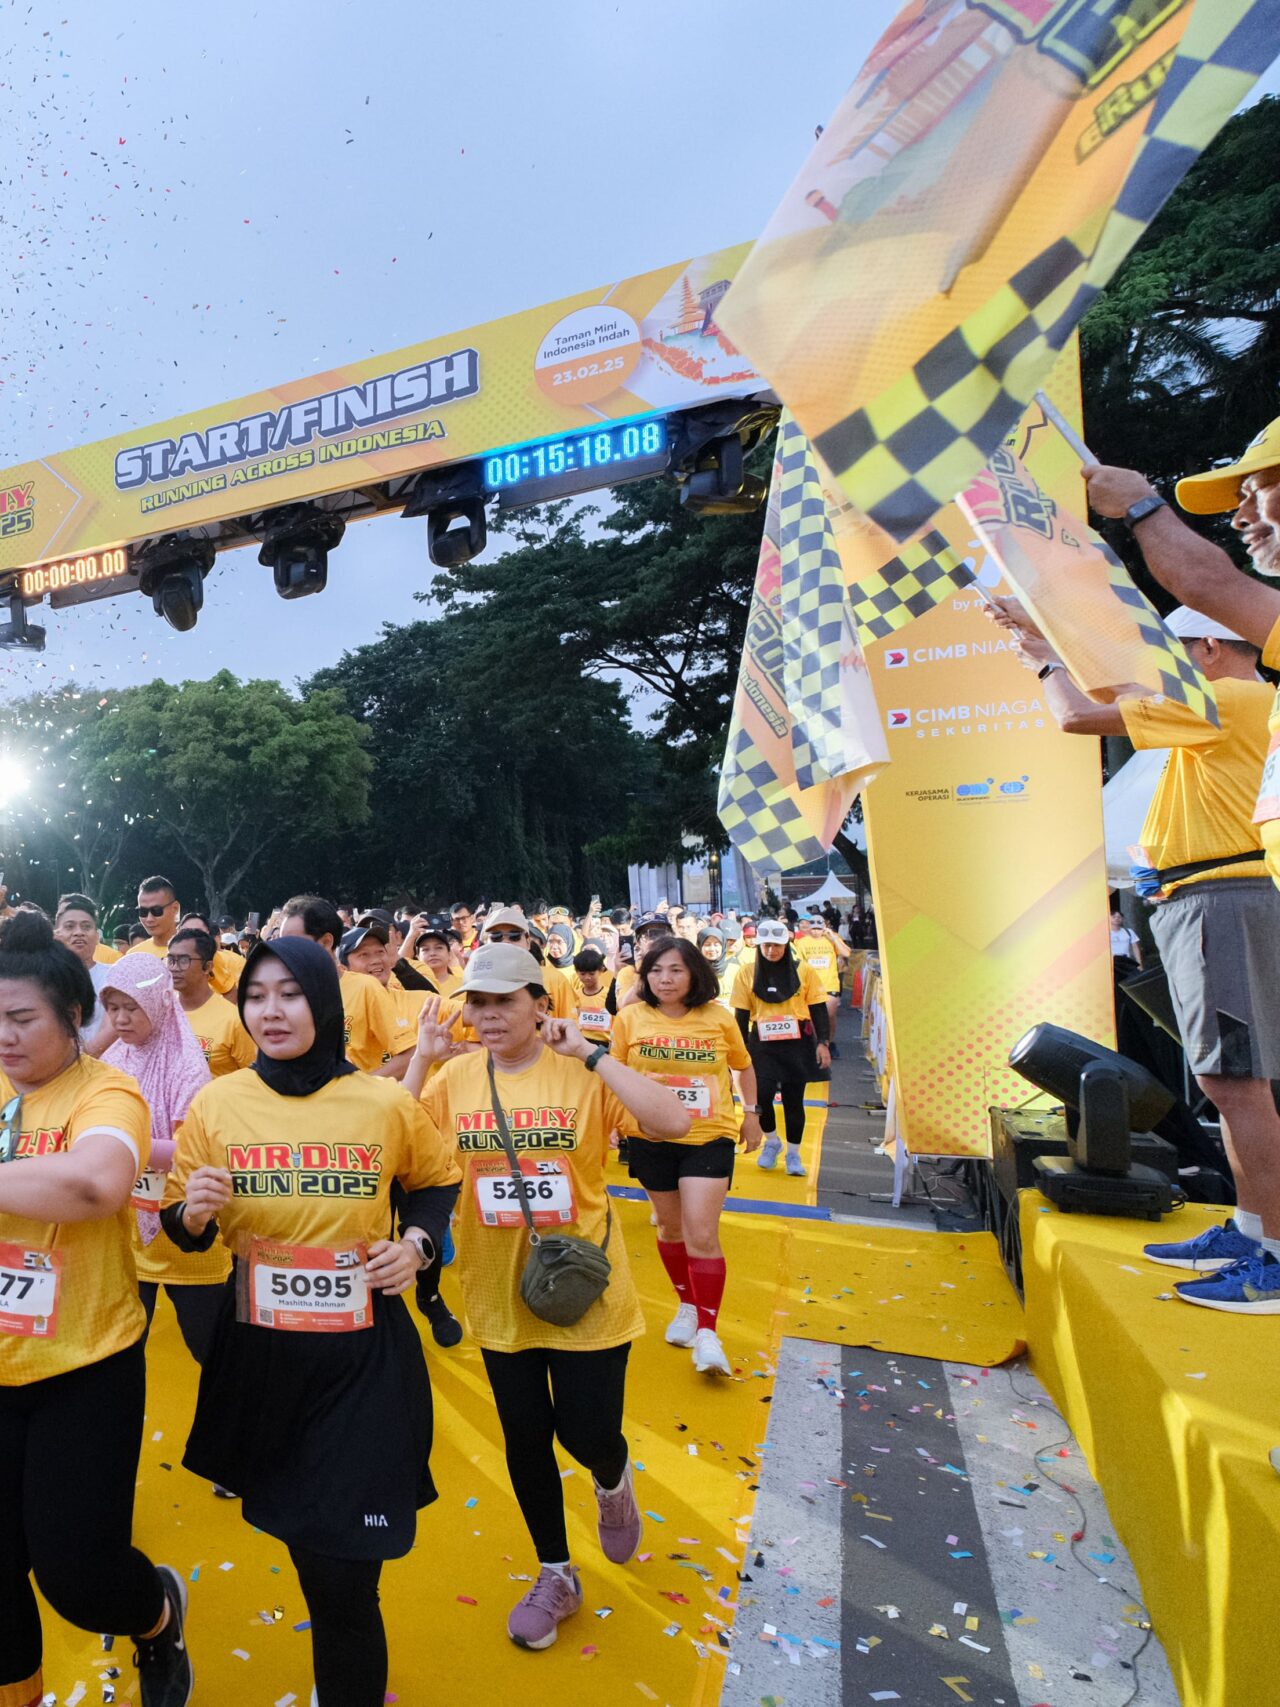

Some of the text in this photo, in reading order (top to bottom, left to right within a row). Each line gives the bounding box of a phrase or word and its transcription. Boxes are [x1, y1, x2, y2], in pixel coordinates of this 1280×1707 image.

[543, 328, 630, 359] Indonesia Indah
[554, 321, 617, 346] Taman Mini
[552, 356, 625, 386] 23.02.25
[115, 348, 479, 489] START/FINISH
[486, 421, 662, 487] 00:15:18.08
[141, 421, 447, 513] RUNNING ACROSS INDONESIA
[23, 549, 126, 596] 00:00:00.00
[952, 599, 971, 613] by
[912, 639, 1021, 663] CIMB NIAG
[916, 698, 1043, 724] CIMB NIAGA
[916, 719, 1045, 738] SEKURITAS
[905, 788, 950, 797] KERJASAMA
[917, 794, 950, 802] OPERASI
[582, 1013, 605, 1022] 5625
[765, 1022, 791, 1031] 5220
[640, 1047, 716, 1061] RUN 2025
[676, 1089, 698, 1101] 63
[513, 1108, 576, 1130] D.I.Y.
[458, 1131, 576, 1151] RUN 2025
[228, 1145, 381, 1173] MR D.I.Y.
[535, 1161, 562, 1176] 5K
[232, 1174, 378, 1198] RUN 2025
[493, 1180, 554, 1200] 5266
[334, 1248, 361, 1269] 5K
[271, 1272, 352, 1298] 5095
[278, 1299, 346, 1308] Mashitha Rahman
